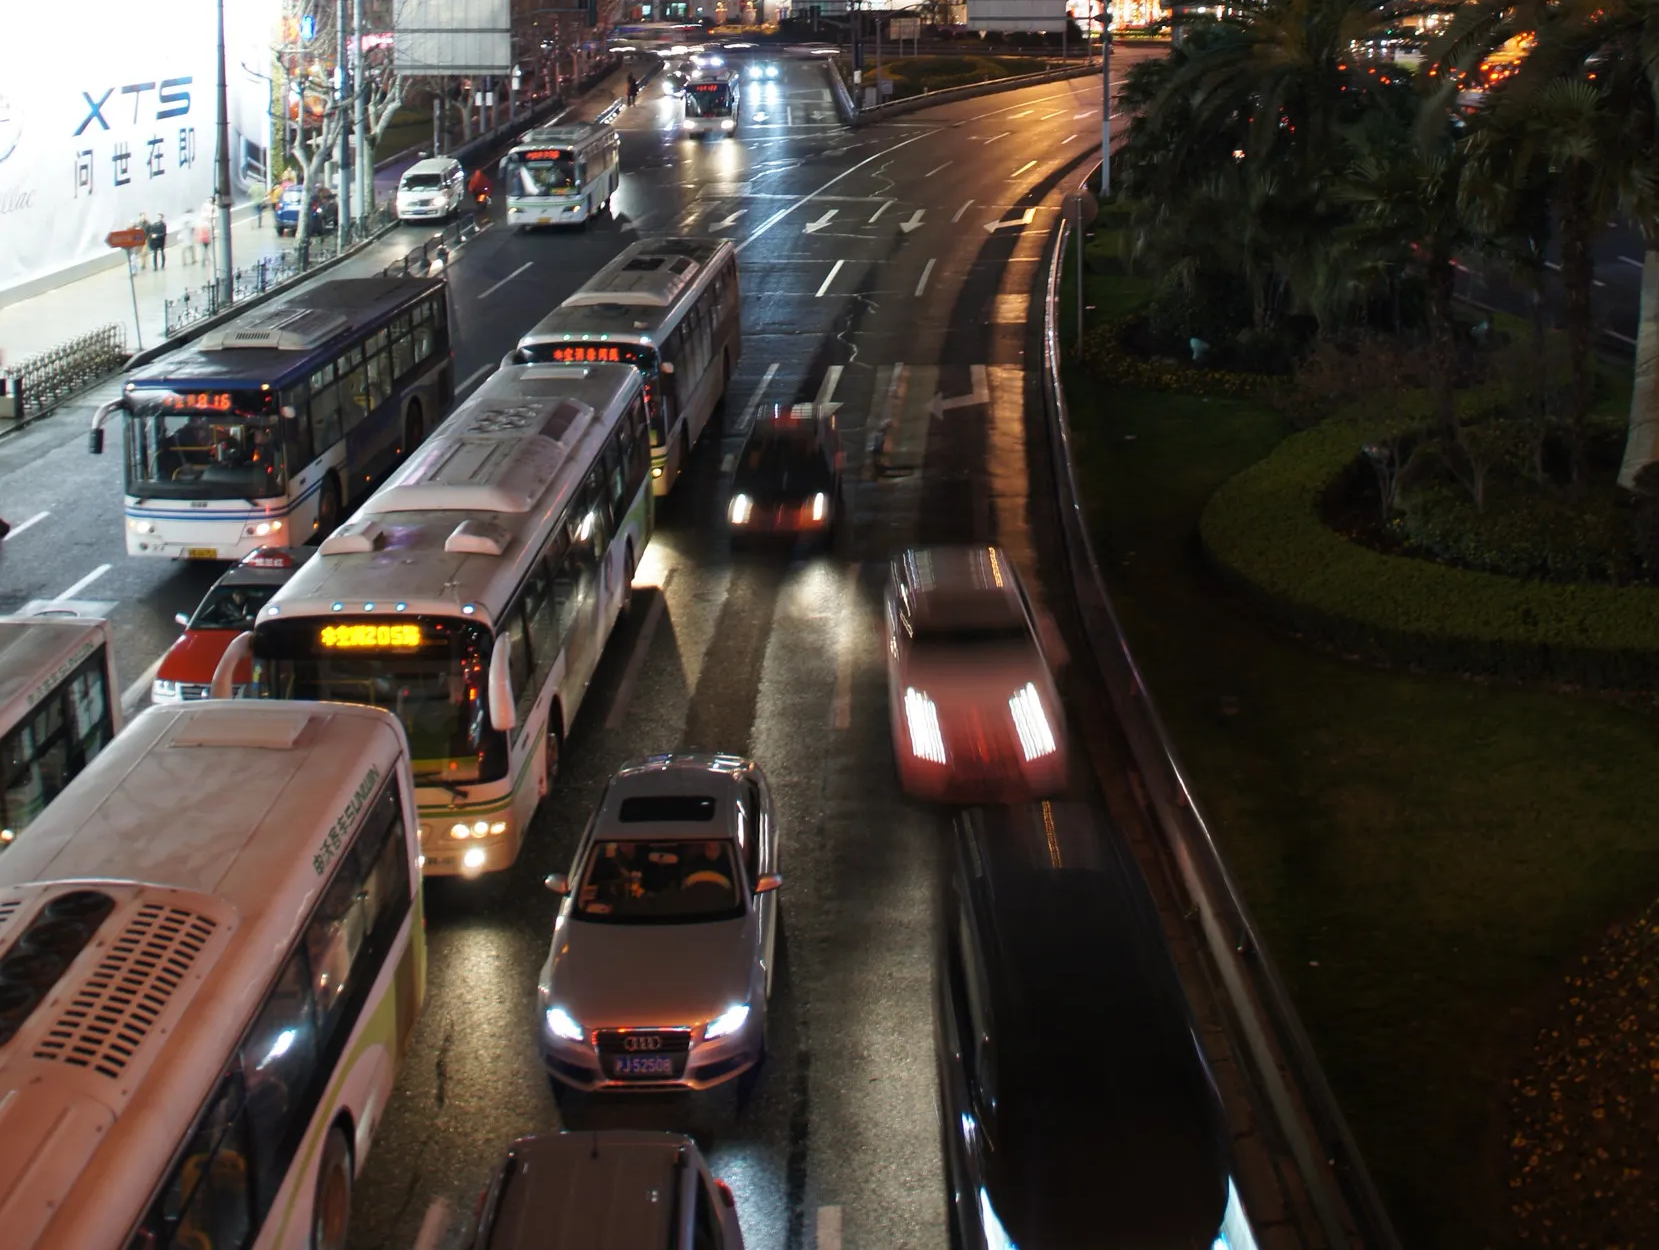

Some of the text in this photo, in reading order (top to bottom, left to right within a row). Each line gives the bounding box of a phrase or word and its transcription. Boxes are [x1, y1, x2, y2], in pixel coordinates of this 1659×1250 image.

[71, 76, 193, 137] XTS
[72, 127, 195, 199] 问世在即
